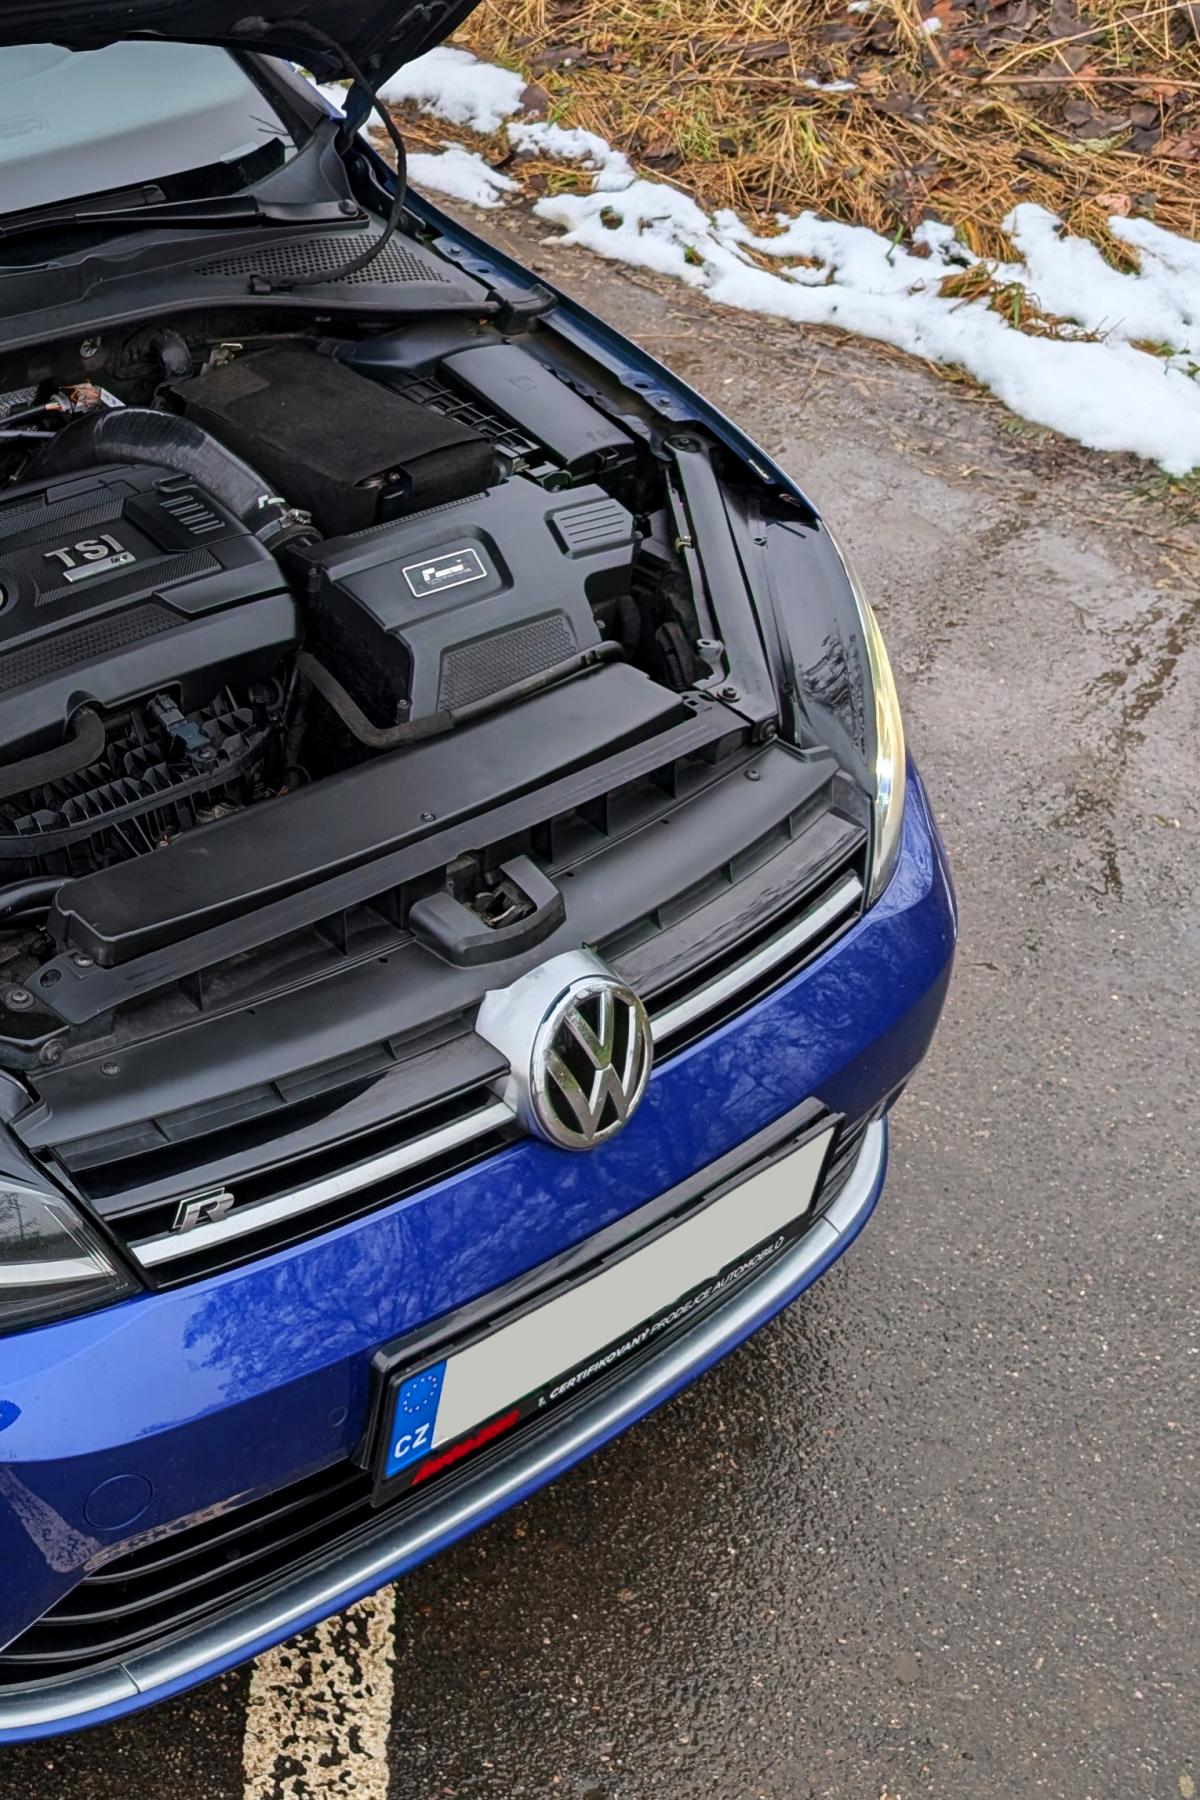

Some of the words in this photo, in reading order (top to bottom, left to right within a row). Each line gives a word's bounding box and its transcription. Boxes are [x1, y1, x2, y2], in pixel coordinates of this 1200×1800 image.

[43, 534, 125, 568] TSI
[536, 981, 649, 1146] VW
[175, 1189, 234, 1233] R
[394, 1422, 430, 1458] CZ
